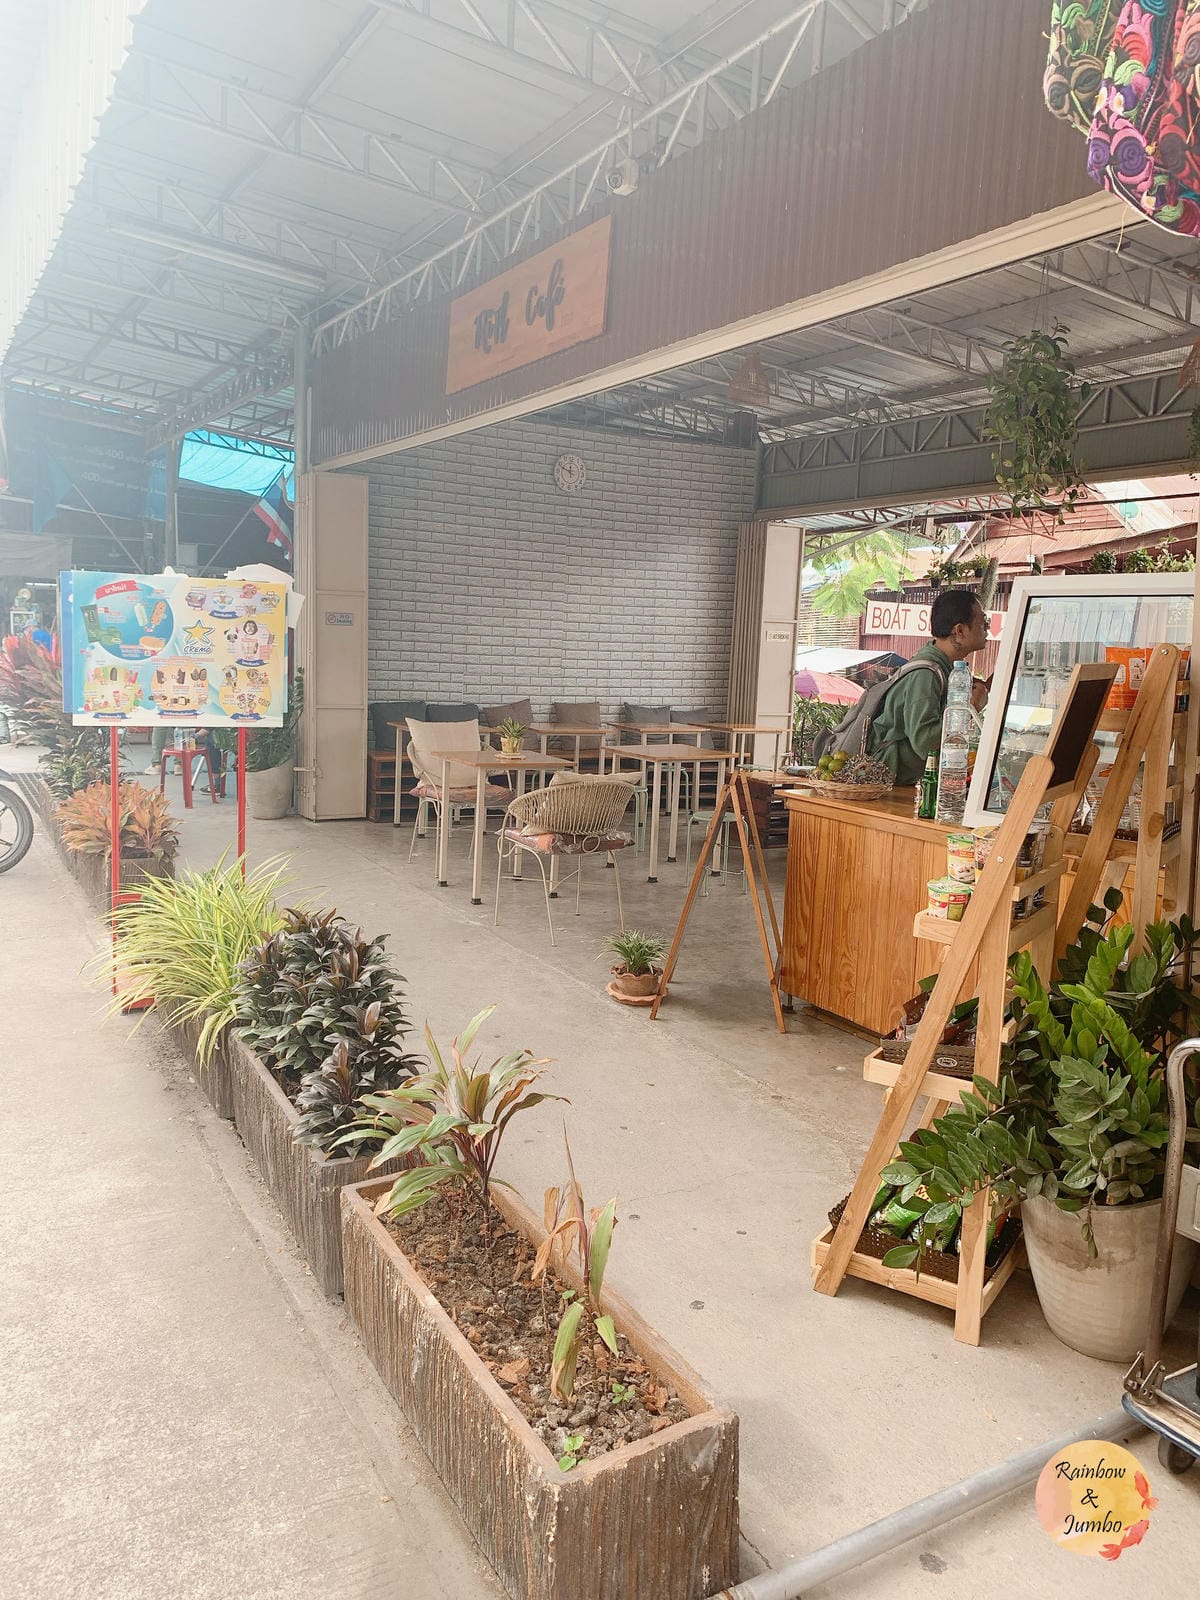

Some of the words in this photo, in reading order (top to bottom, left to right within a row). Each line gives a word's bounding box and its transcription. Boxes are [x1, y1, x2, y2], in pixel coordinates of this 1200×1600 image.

[526, 258, 565, 331] Café
[871, 606, 911, 630] BOAT
[183, 644, 213, 653] CREMO
